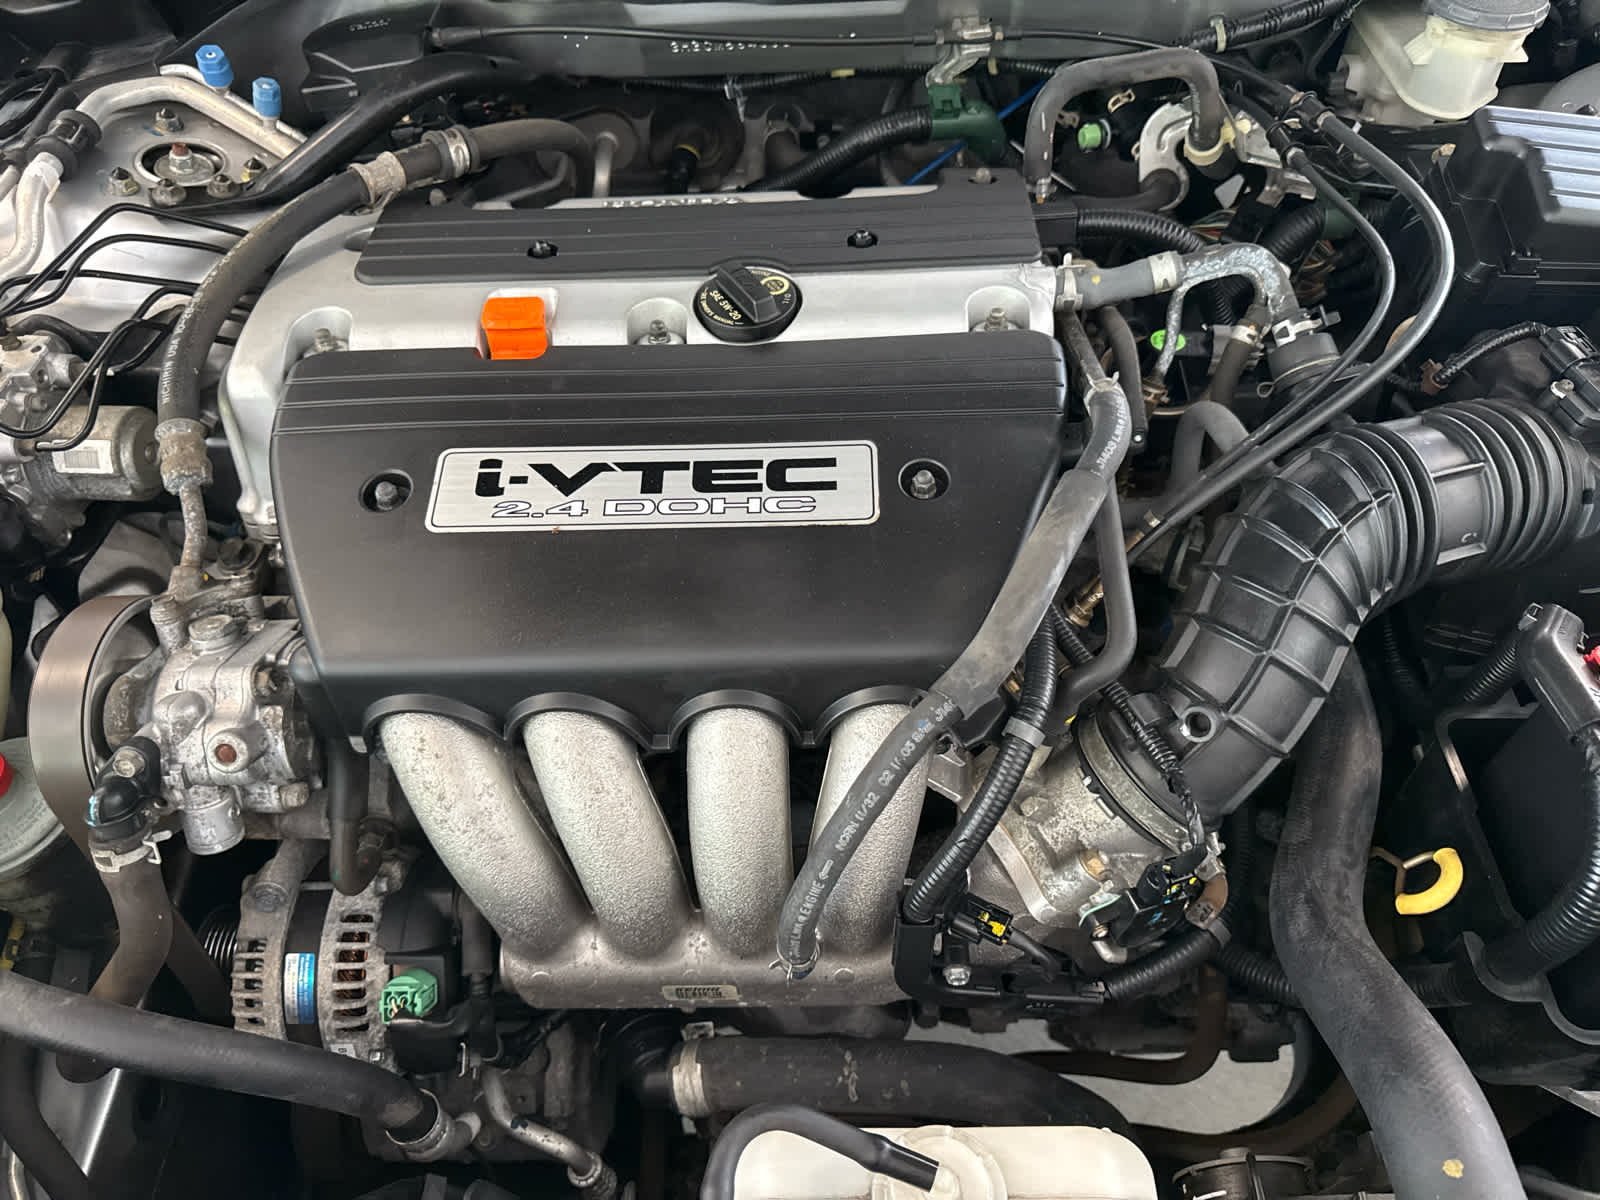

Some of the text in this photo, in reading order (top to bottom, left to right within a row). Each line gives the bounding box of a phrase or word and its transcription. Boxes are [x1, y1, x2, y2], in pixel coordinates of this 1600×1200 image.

[709, 290, 726, 303] SAE
[719, 299, 743, 321] 5W-20
[168, 338, 181, 358] USA
[474, 456, 838, 498] i-VTEC
[491, 495, 817, 518] 2.4 DOHC
[800, 880, 825, 916] ENGINE
